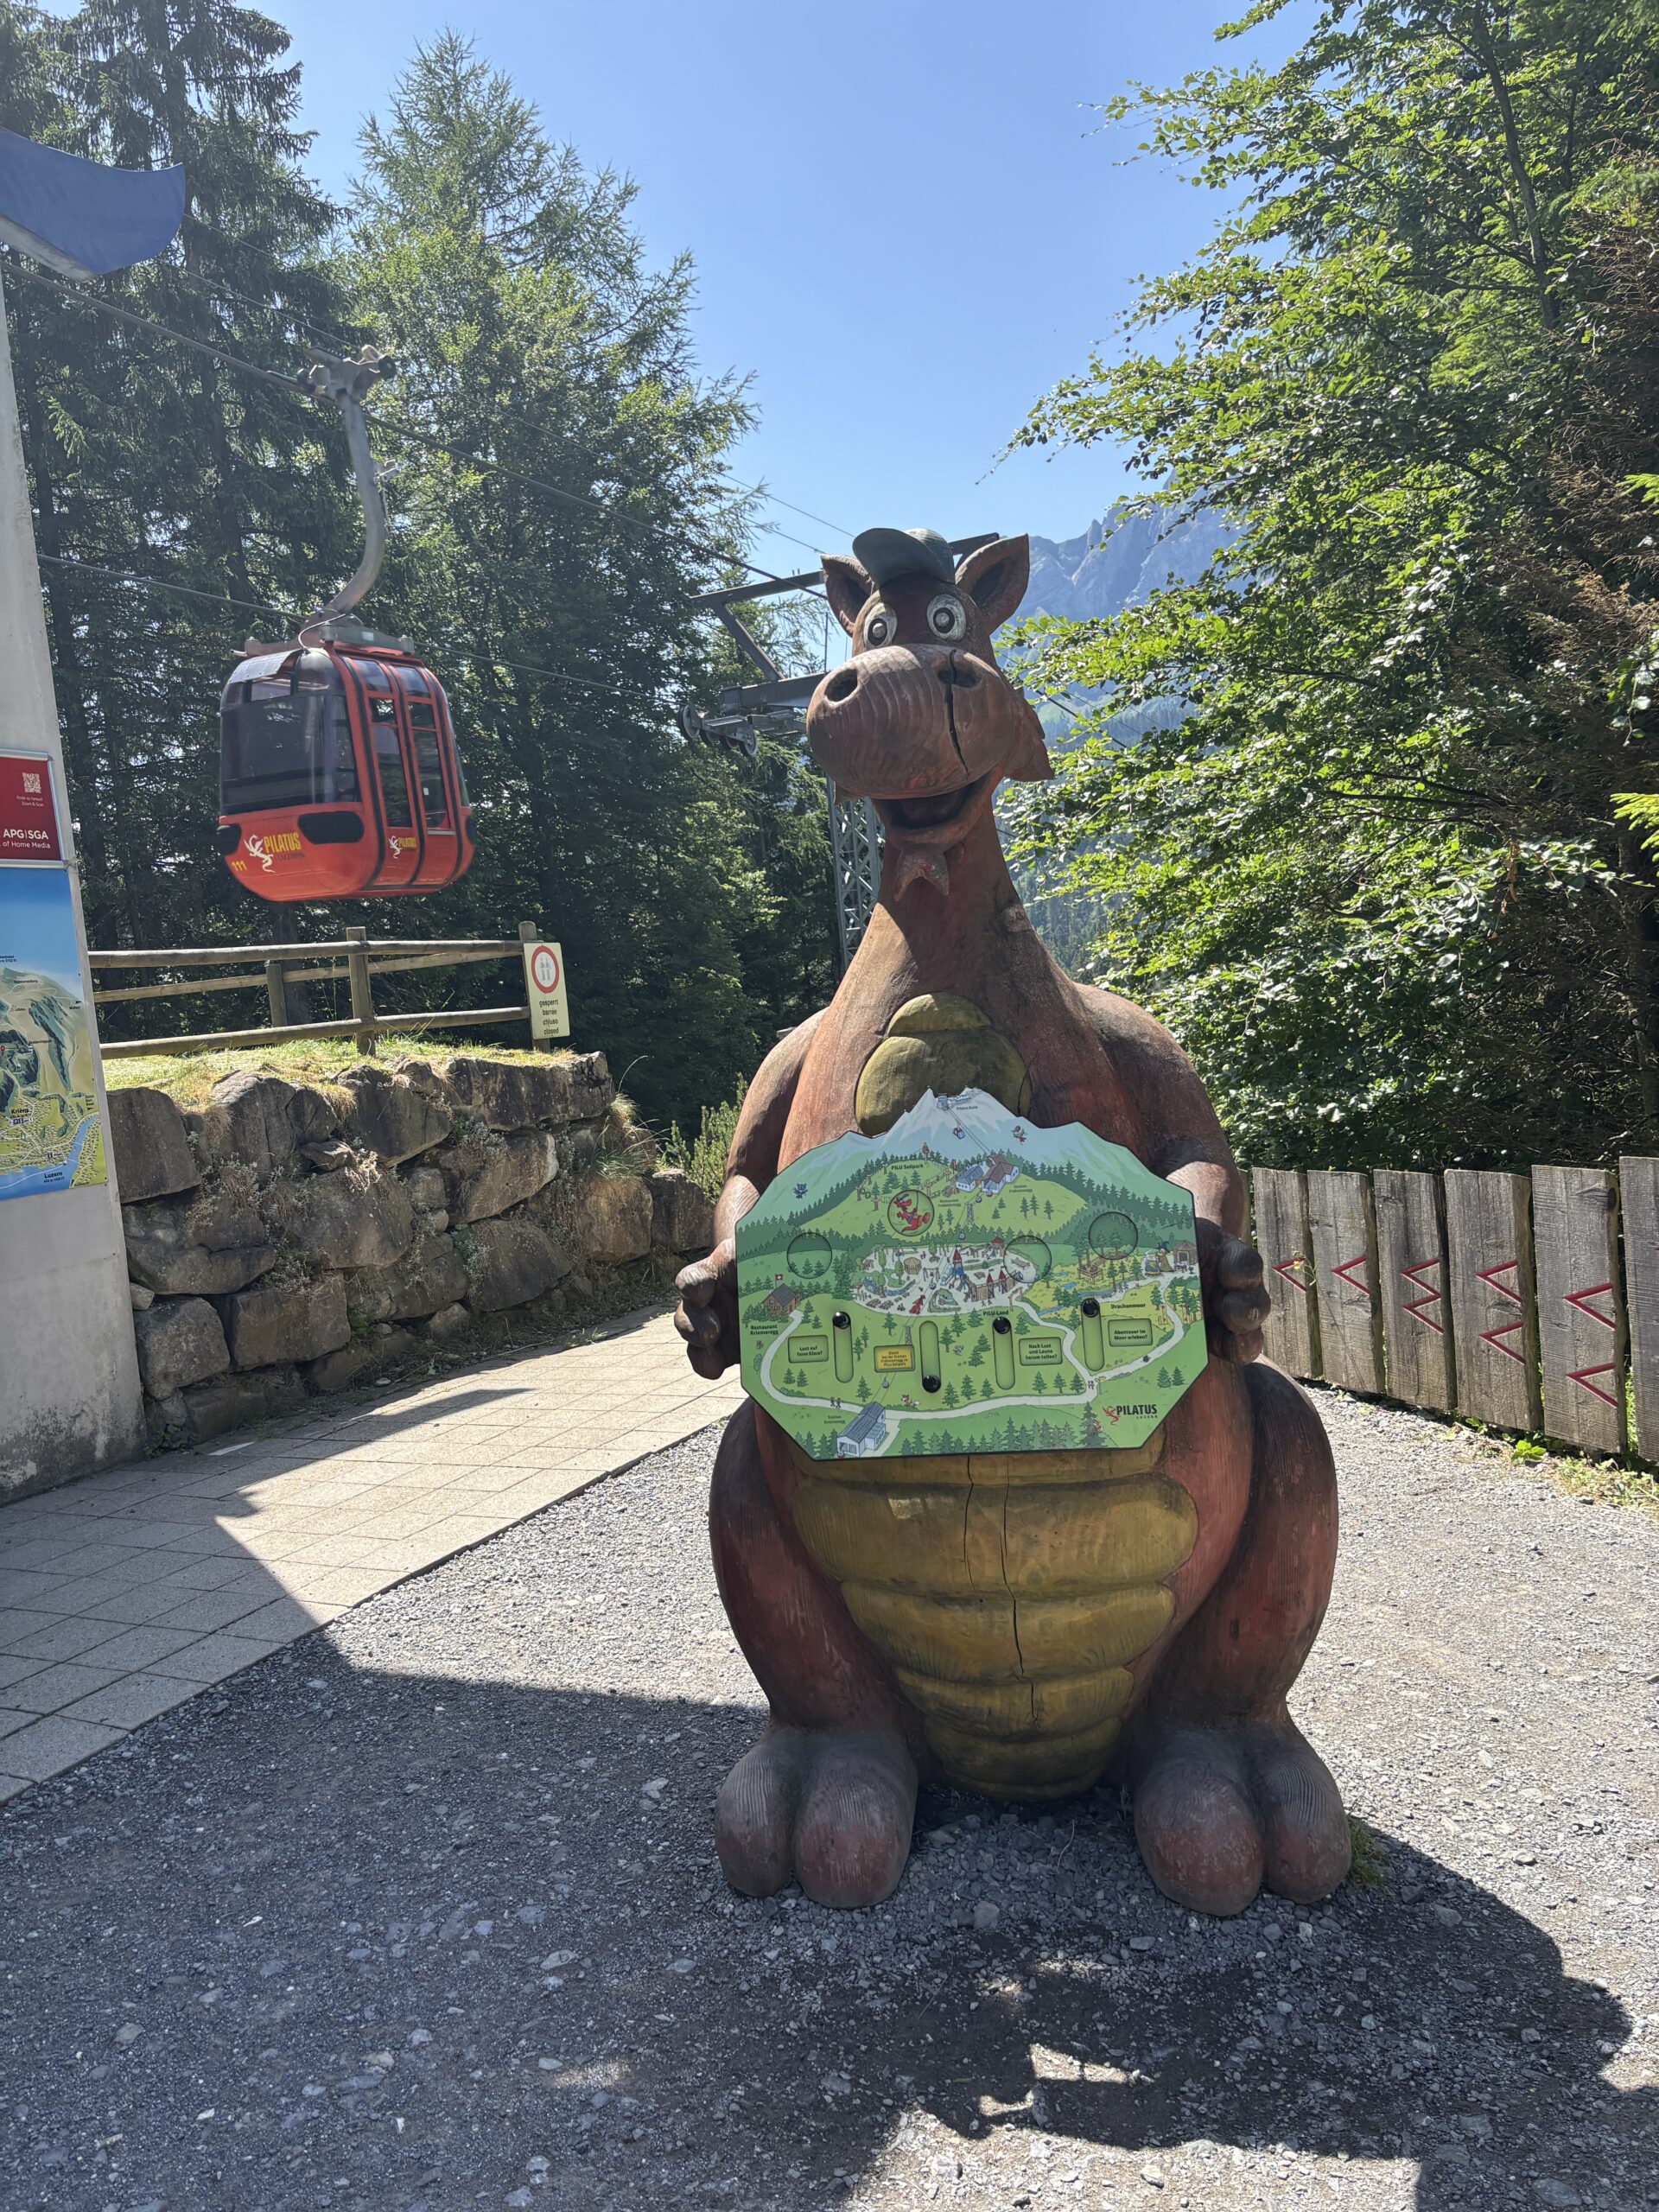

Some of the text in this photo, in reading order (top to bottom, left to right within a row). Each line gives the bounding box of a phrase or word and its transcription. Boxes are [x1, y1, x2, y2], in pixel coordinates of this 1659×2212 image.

[264, 832, 302, 854] PILATUS
[232, 861, 247, 872] 111
[539, 999, 559, 1008] gesperrt
[1116, 1404, 1157, 1415] PILATUS
